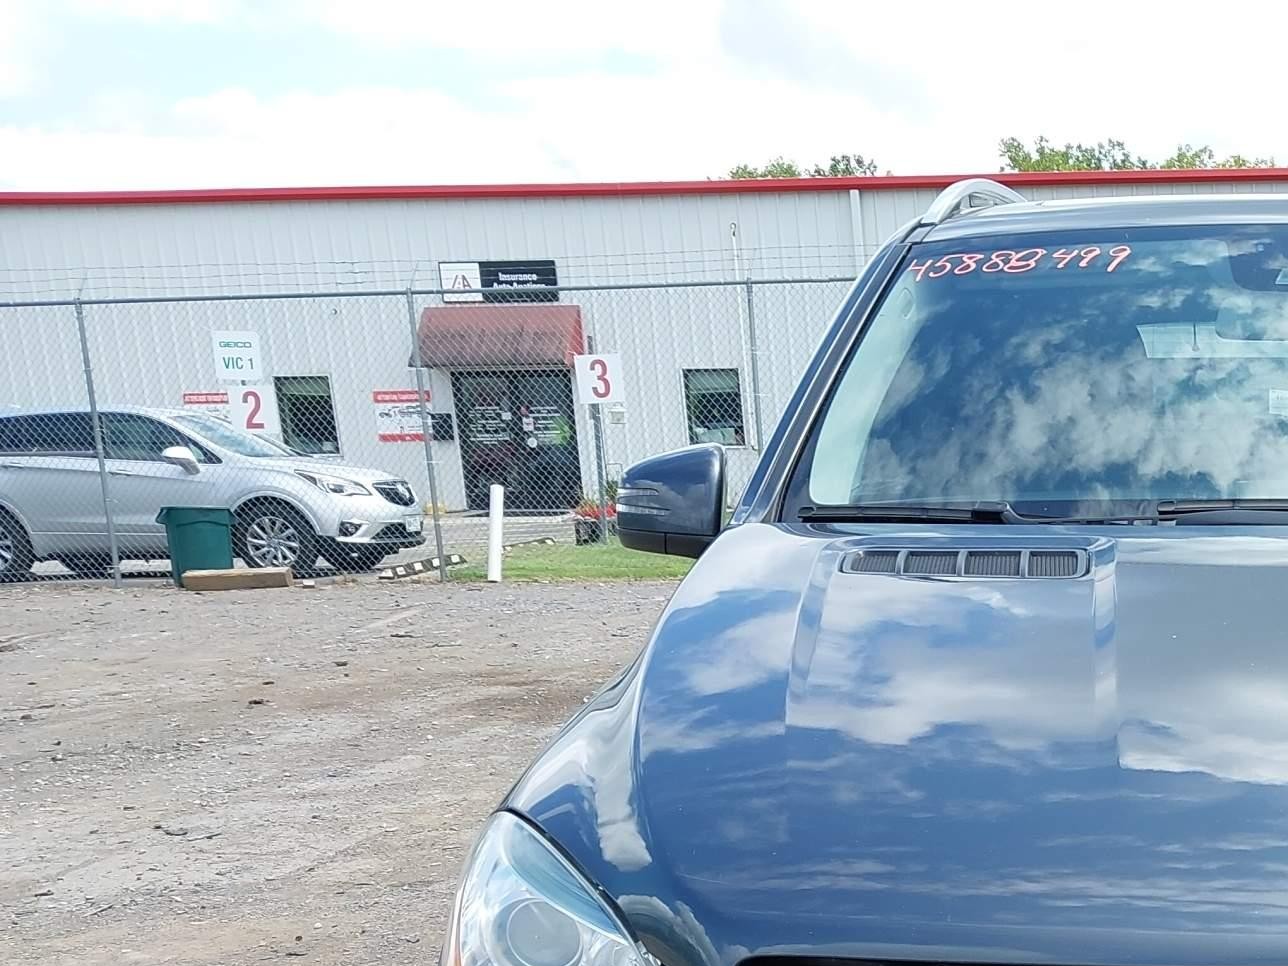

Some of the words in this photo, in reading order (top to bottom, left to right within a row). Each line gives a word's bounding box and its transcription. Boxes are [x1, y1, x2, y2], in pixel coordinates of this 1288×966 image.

[909, 245, 1132, 282] 45888499
[218, 341, 252, 349] GEICO
[222, 356, 244, 370] VIC
[247, 357, 254, 370] 1
[590, 359, 611, 398] 3
[242, 391, 265, 429] 2
